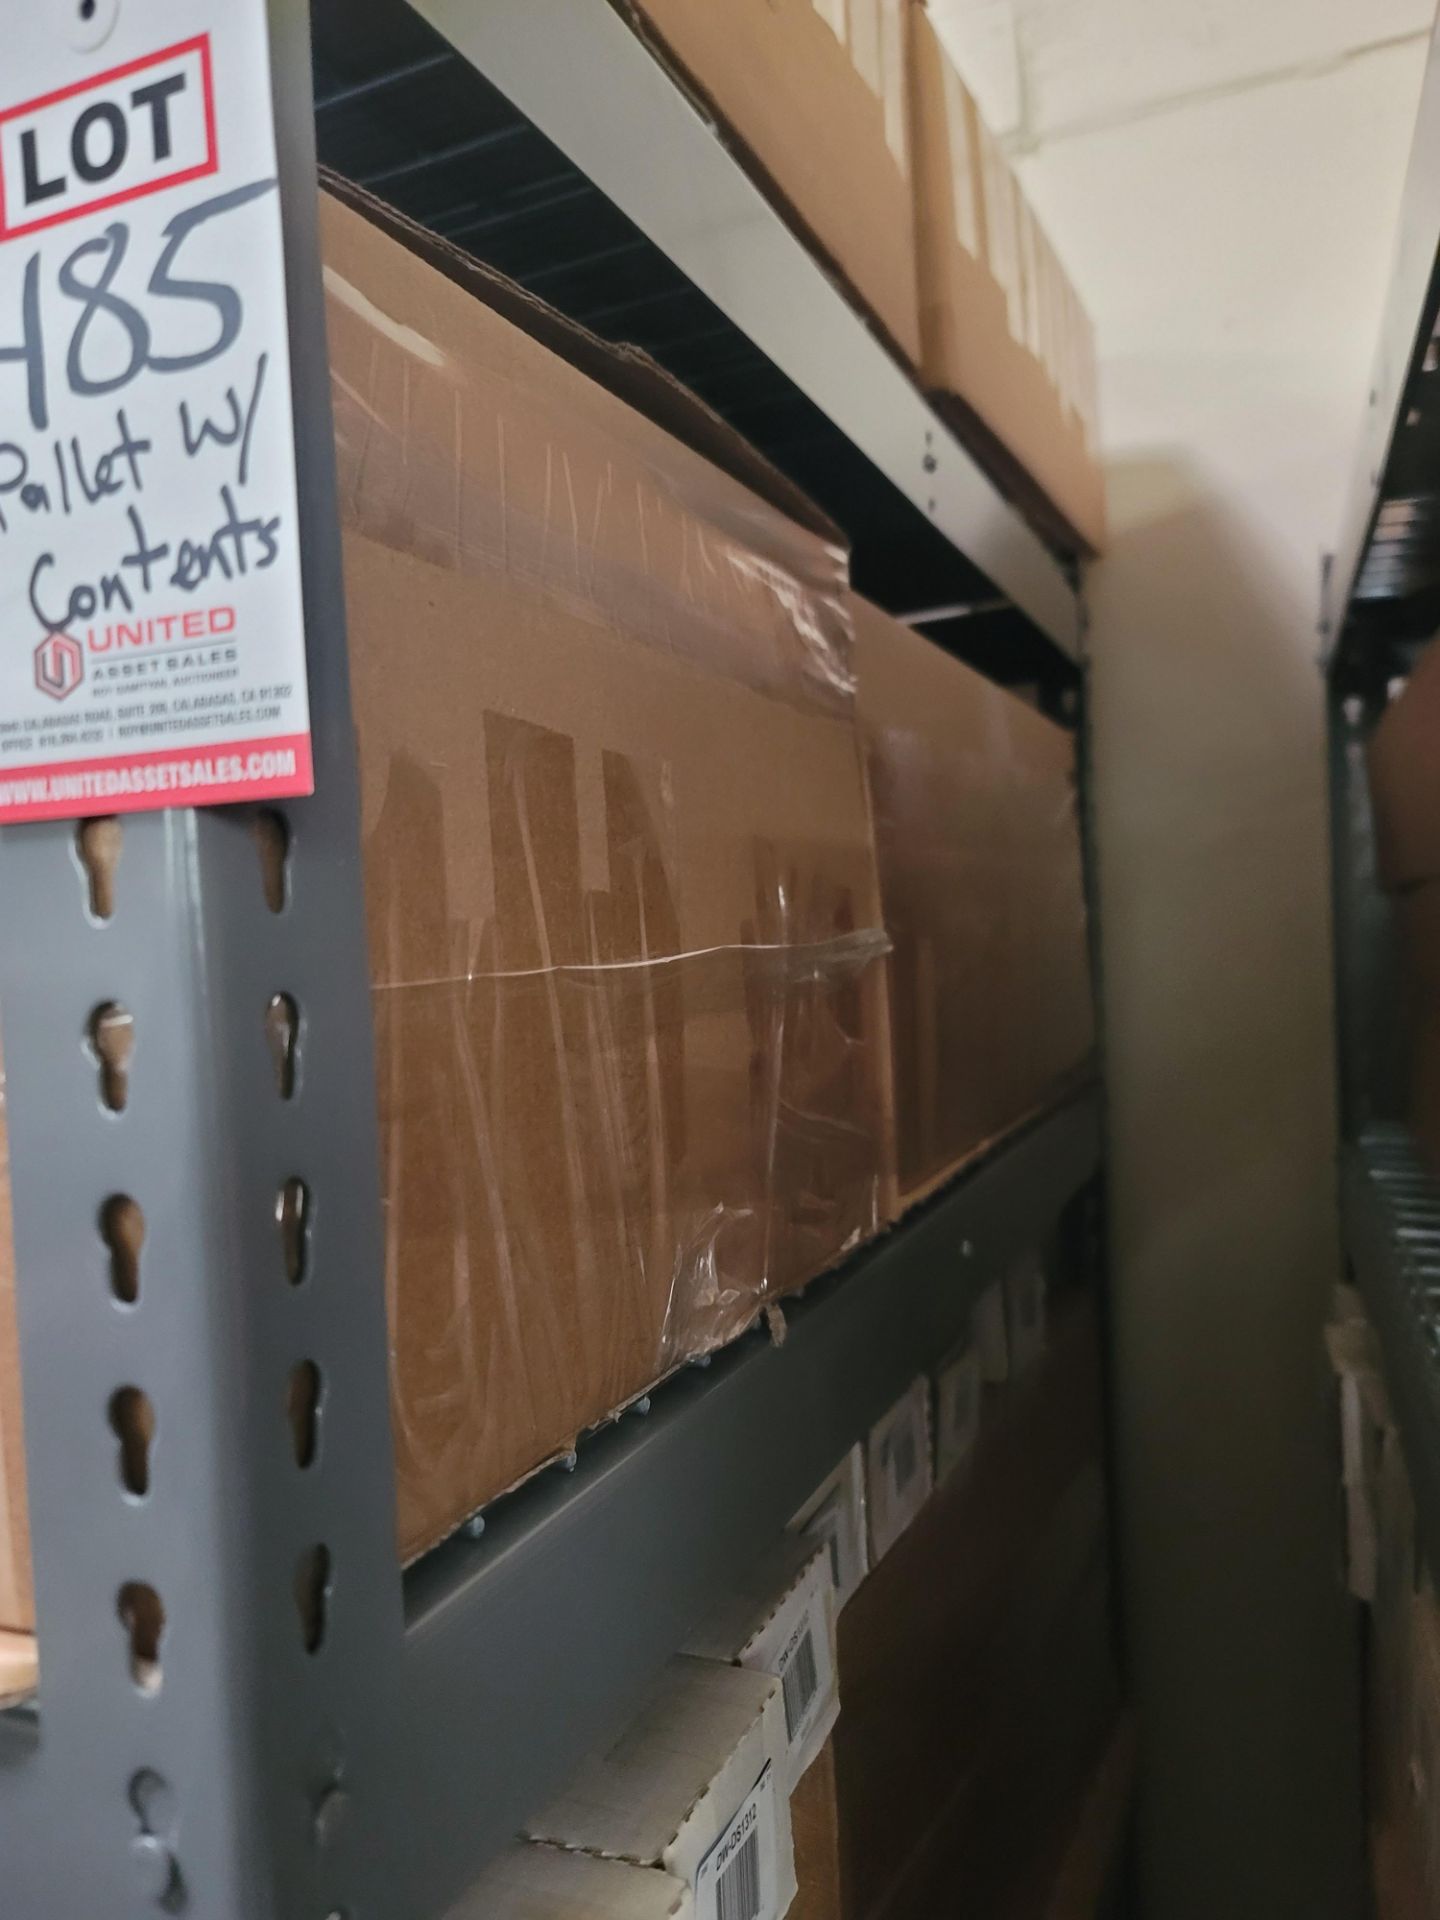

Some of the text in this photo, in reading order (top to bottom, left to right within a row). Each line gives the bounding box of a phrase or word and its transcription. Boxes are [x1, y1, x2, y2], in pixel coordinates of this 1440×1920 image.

[20, 72, 187, 207] LOT
[30, 484, 281, 634] Contents
[87, 605, 237, 653] UNITED
[93, 649, 238, 681] ASSET SALES
[715, 1802, 757, 1872] DW-DS1312
